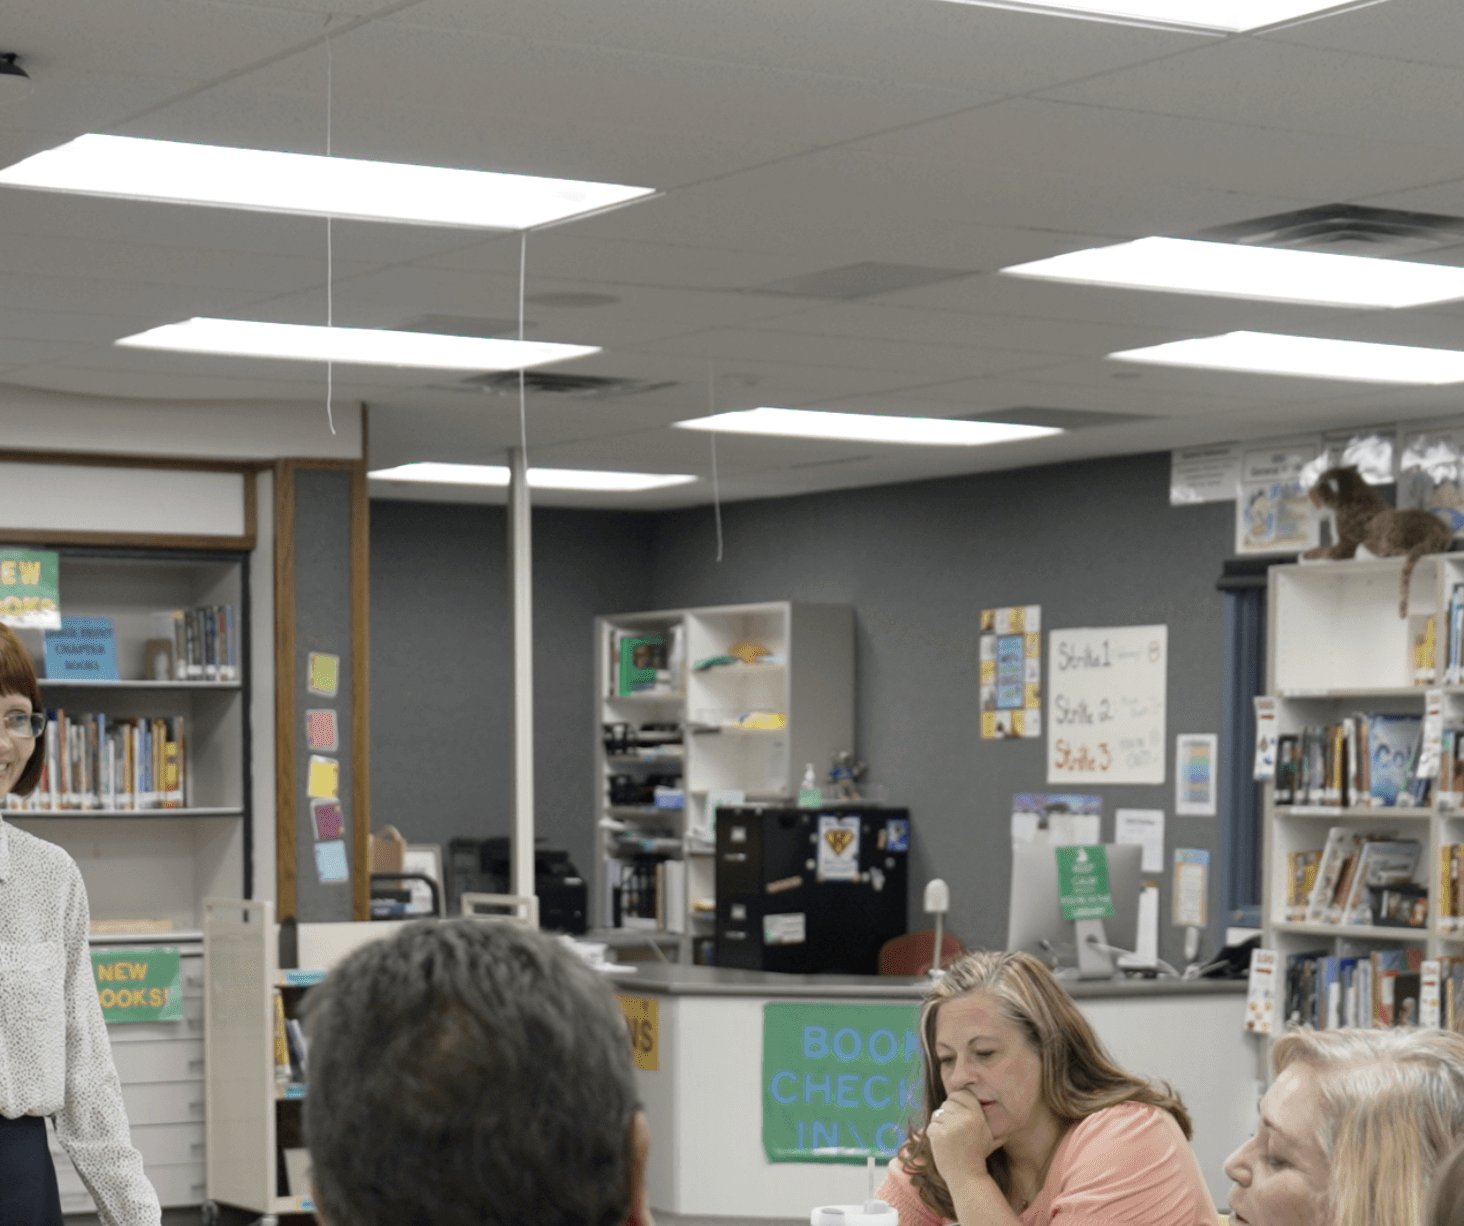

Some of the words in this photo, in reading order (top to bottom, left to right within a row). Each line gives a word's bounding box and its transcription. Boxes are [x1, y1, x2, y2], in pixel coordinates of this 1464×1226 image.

[97, 963, 147, 981] NEW
[98, 987, 169, 1008] OOKS!
[770, 1070, 924, 1109] CHECK
